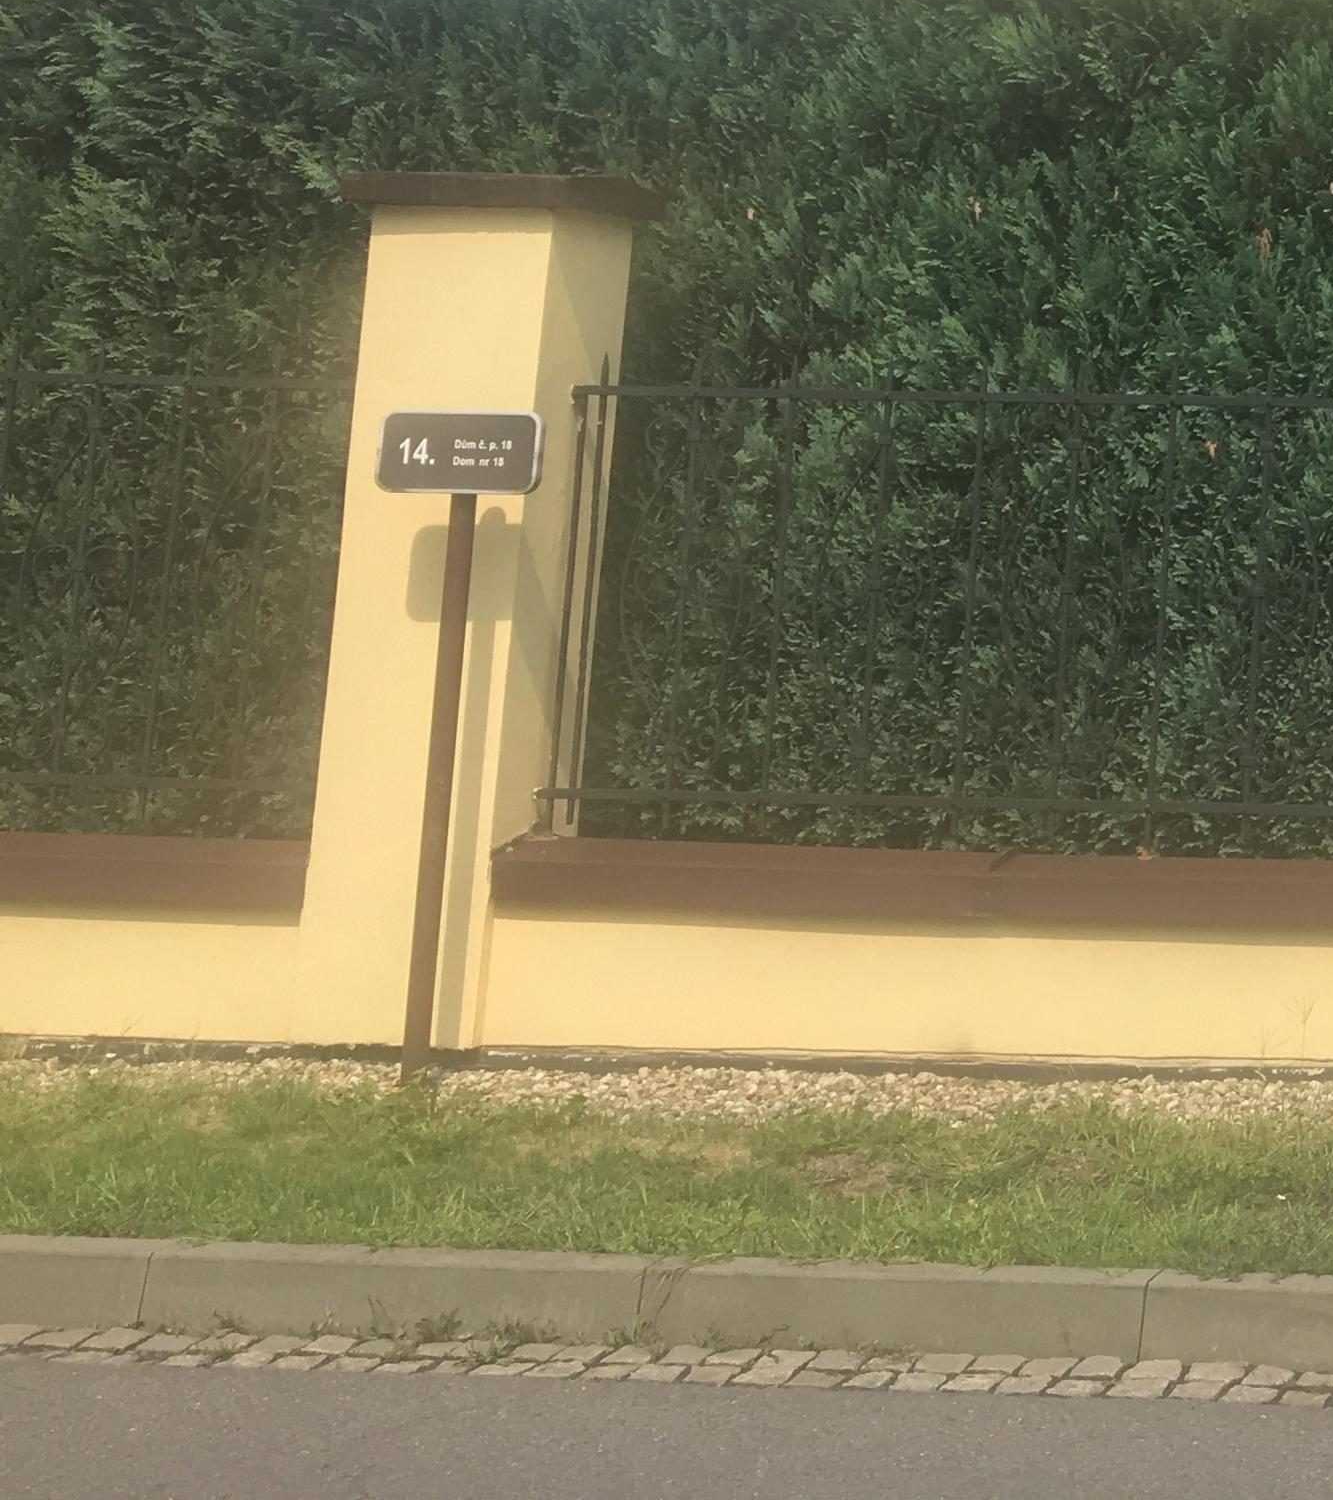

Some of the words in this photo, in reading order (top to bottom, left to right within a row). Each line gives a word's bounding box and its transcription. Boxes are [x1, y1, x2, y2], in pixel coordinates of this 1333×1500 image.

[454, 439, 476, 450] Dům
[479, 439, 487, 450] č.
[489, 442, 498, 451] p.
[501, 440, 512, 450] 18
[399, 438, 436, 465] 14.
[453, 456, 475, 466] Dom
[479, 458, 490, 467] nr
[493, 457, 504, 467] 18
